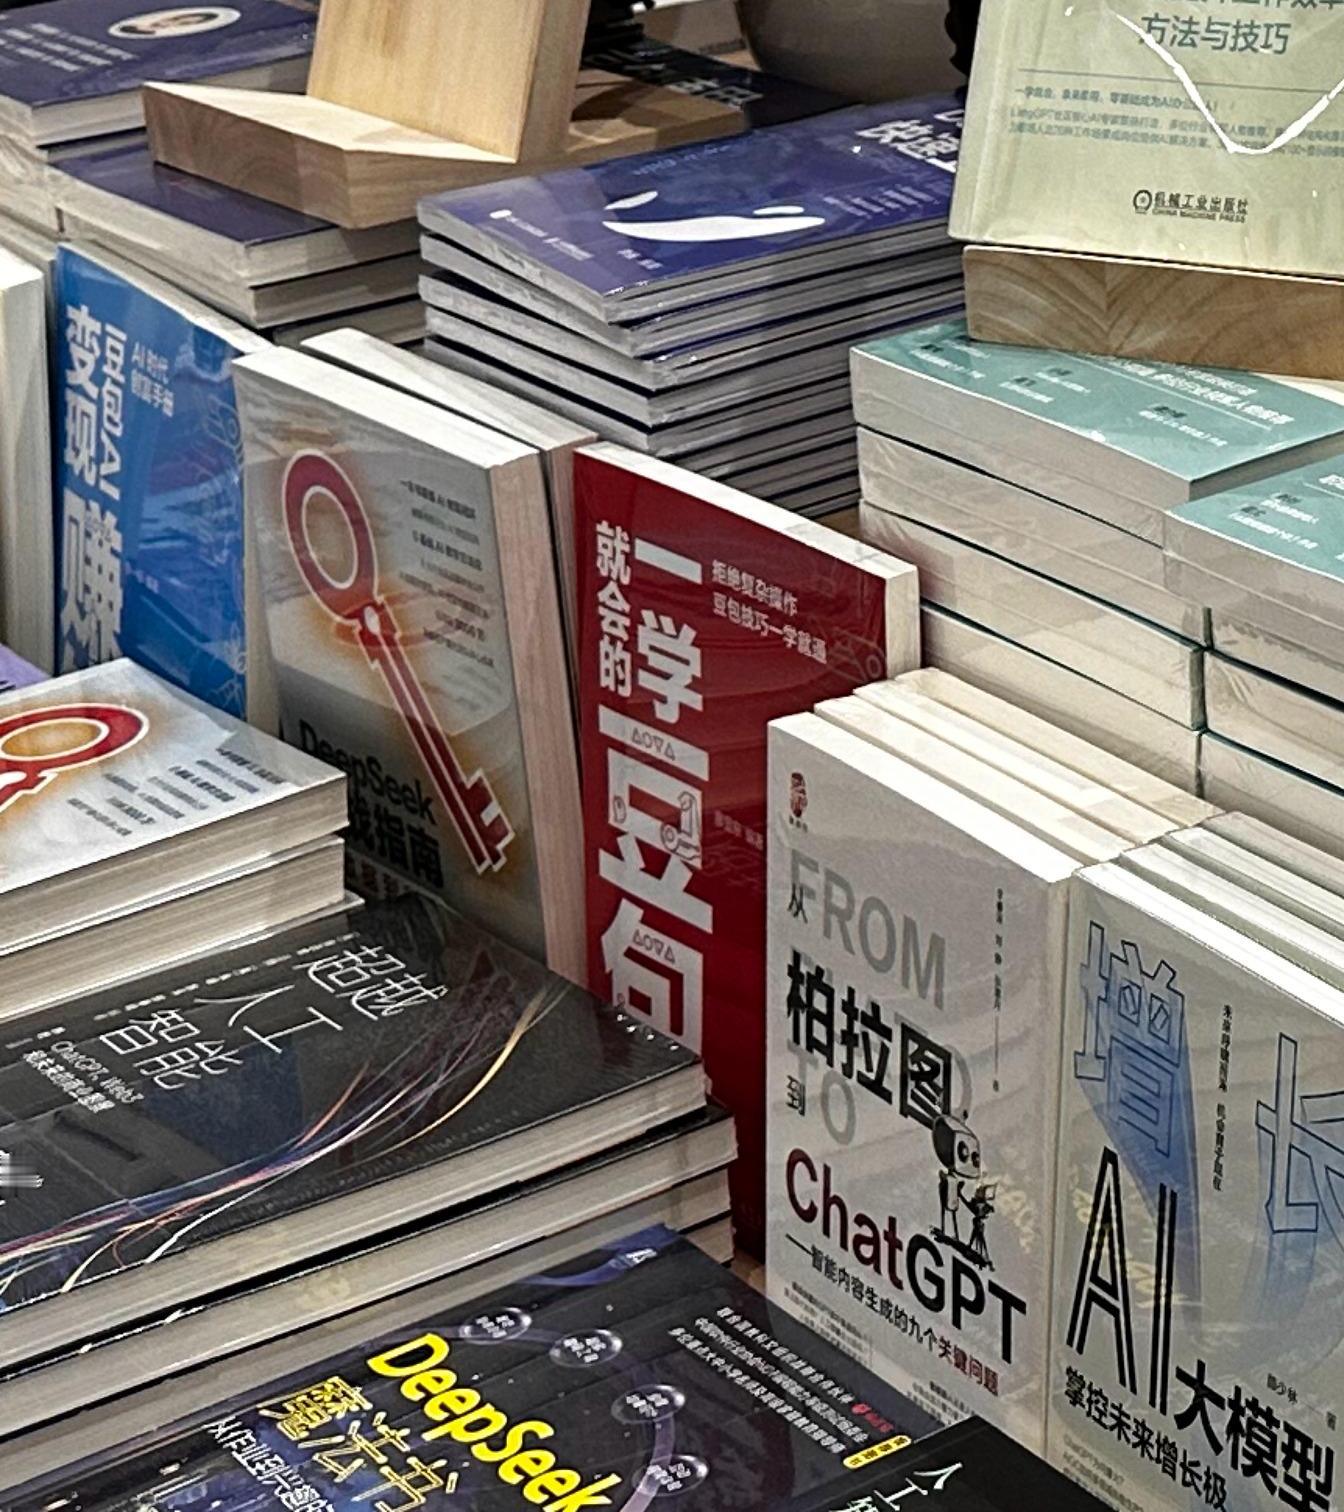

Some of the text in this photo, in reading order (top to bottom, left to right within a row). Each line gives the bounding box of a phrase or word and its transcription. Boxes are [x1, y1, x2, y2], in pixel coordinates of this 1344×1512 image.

[1140, 13, 1290, 55] 方法与技巧
[1154, 191, 1249, 215] 机械工业出版社
[63, 302, 104, 487] 变现
[595, 519, 633, 700] 就会的
[710, 559, 799, 618] 拒绝复杂操作
[300, 718, 437, 826] DeepSeek
[785, 949, 953, 1129] 柏拉图
[785, 1147, 1028, 1365] ChatGPT
[367, 1333, 622, 1512] DeepSeek
